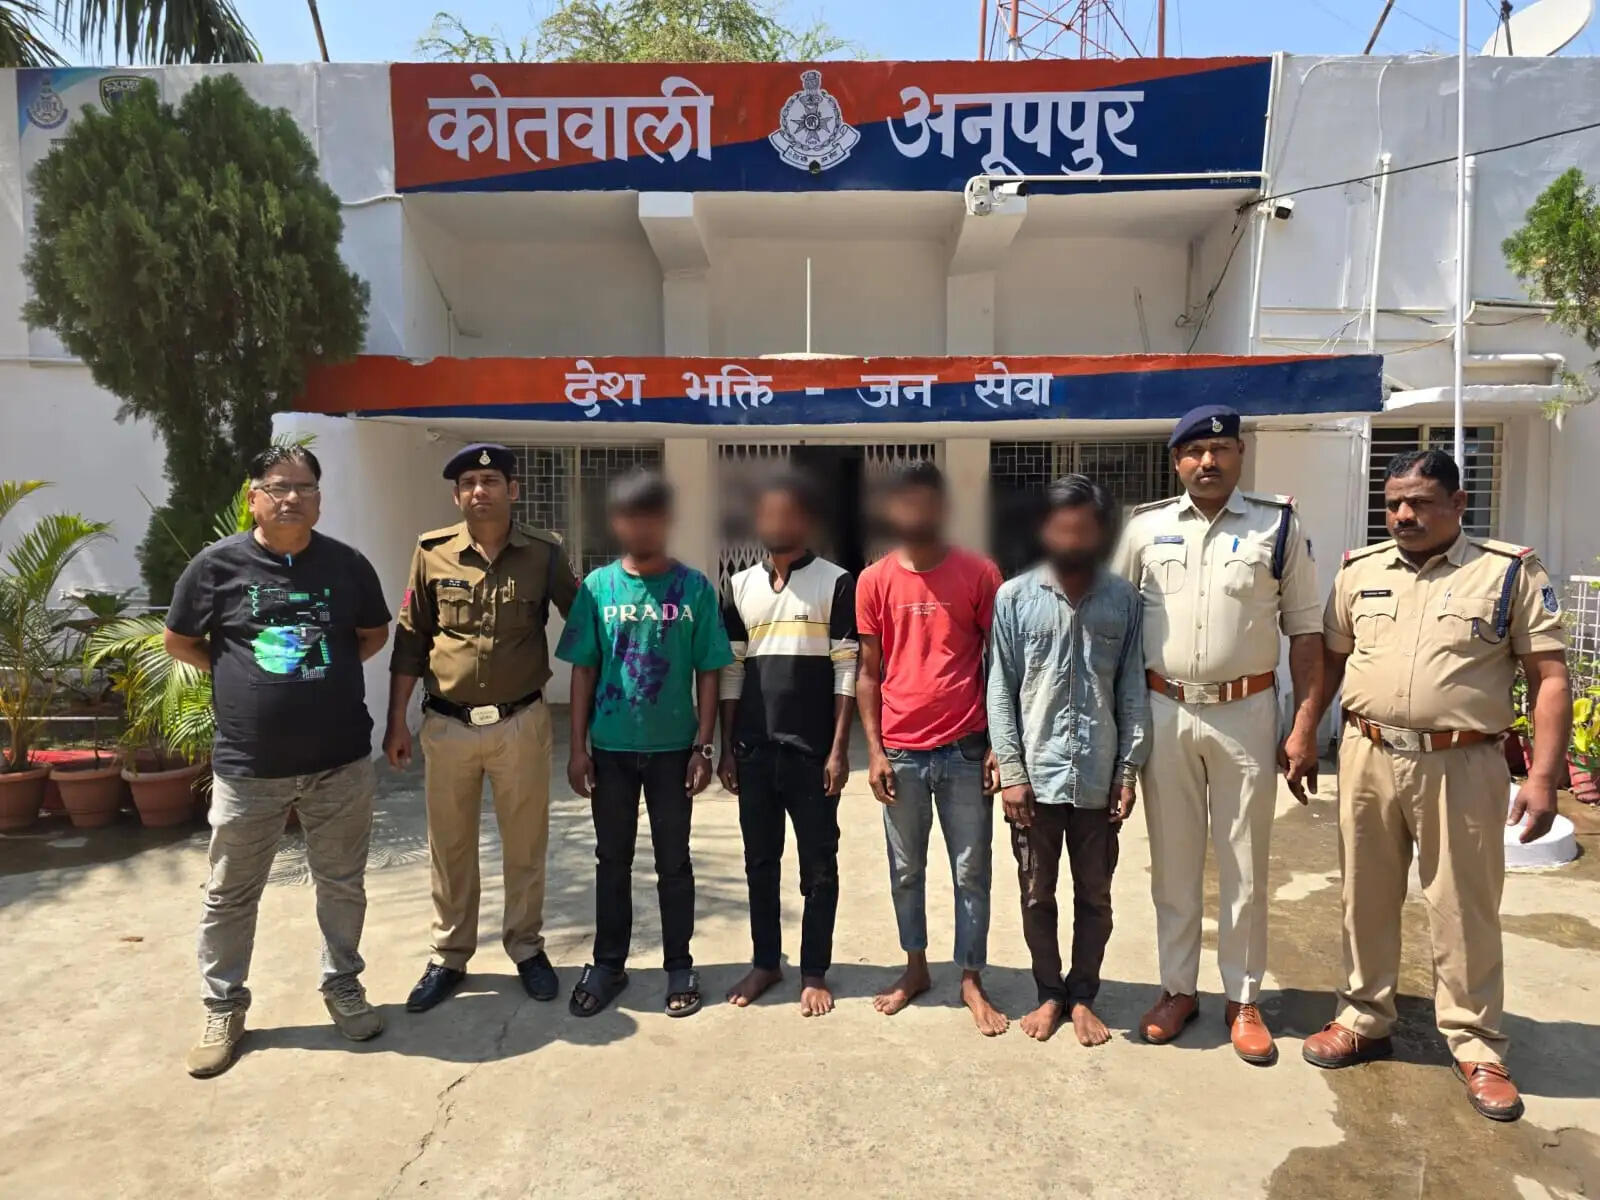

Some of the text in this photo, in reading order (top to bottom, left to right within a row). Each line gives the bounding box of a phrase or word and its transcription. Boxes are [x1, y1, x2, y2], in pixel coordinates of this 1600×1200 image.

[427, 75, 1146, 179] कोतवाली अनूपपुर
[564, 359, 646, 418] देश
[683, 364, 774, 410] भक्ति
[857, 373, 939, 408] जन
[974, 361, 1054, 409] सेवा
[603, 603, 694, 623] PRADA
